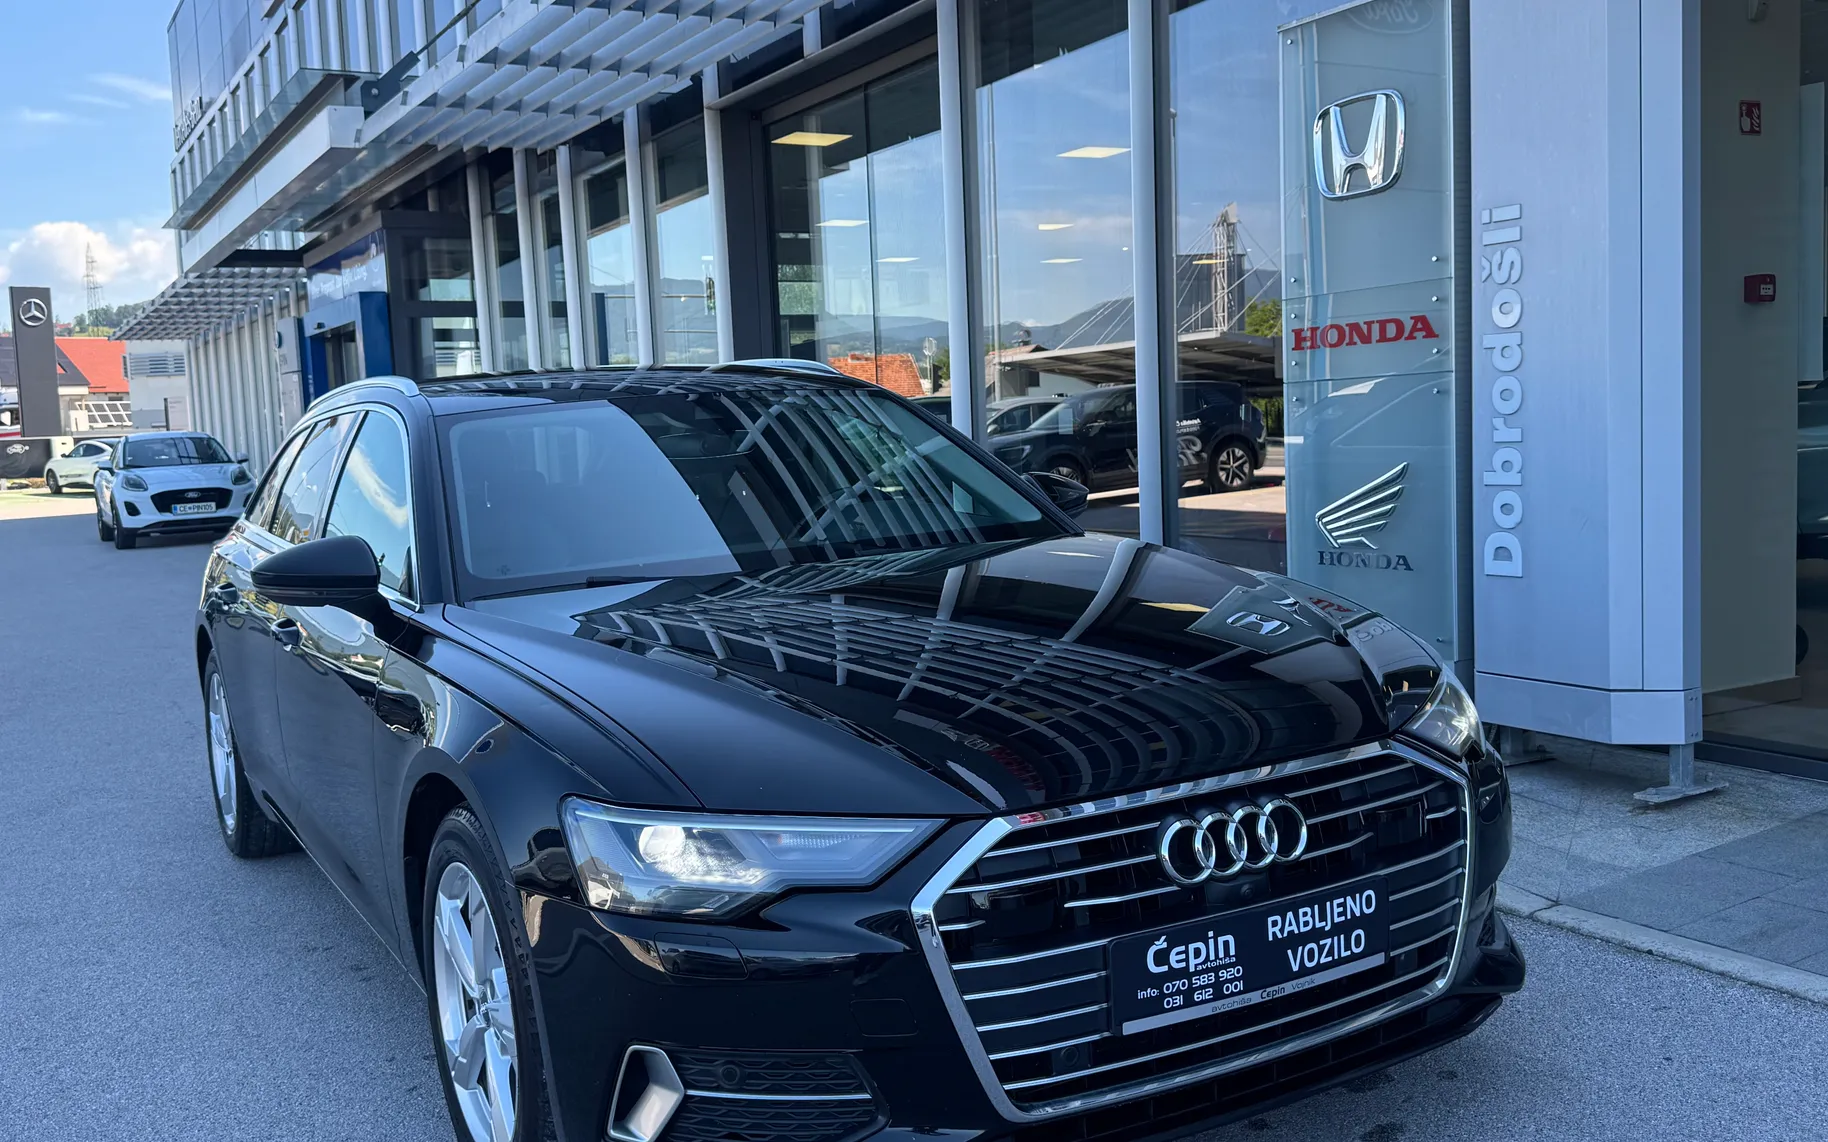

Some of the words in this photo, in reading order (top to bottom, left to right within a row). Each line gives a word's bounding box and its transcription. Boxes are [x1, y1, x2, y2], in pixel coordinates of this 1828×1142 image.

[1291, 314, 1440, 351] HONDA
[1481, 203, 1523, 578] Dobrodošli
[1317, 550, 1414, 571] HONDA
[1267, 889, 1376, 941] RABLJENO
[1146, 930, 1236, 974] Čepin
[1196, 956, 1236, 971] avtohiša
[1287, 929, 1365, 972] VOZILO
[1137, 987, 1160, 999] info:
[1163, 979, 1188, 994] 070
[1192, 972, 1215, 988] 583
[1218, 965, 1243, 981] 920
[1163, 995, 1184, 1009] 031
[1193, 987, 1213, 1002] 612
[1223, 980, 1244, 995] 001
[1260, 986, 1286, 1000] Čepin
